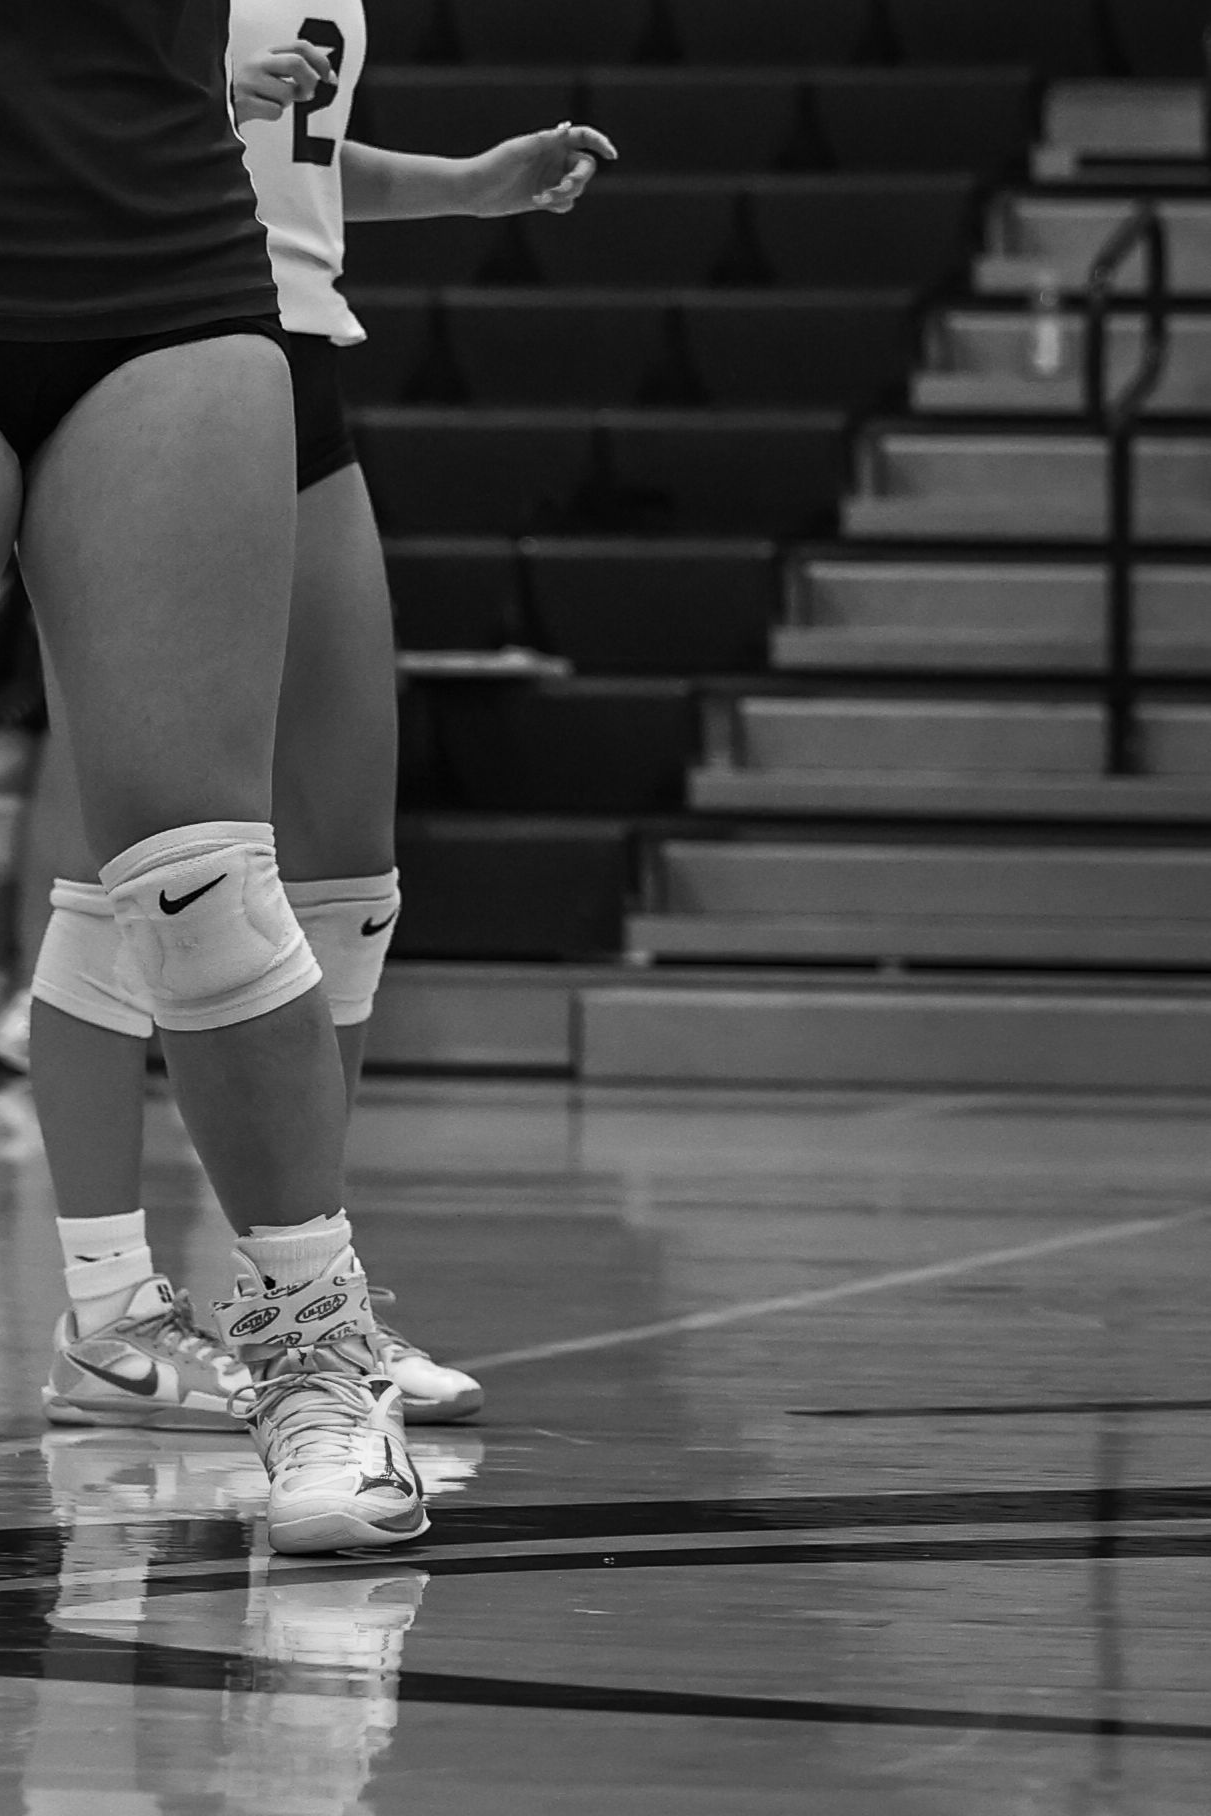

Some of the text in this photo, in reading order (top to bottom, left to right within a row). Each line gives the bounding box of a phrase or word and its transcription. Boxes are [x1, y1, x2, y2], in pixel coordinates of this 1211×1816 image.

[293, 17, 345, 167] 2
[303, 1296, 342, 1319] ULTRA
[236, 1310, 272, 1333] ULTRA
